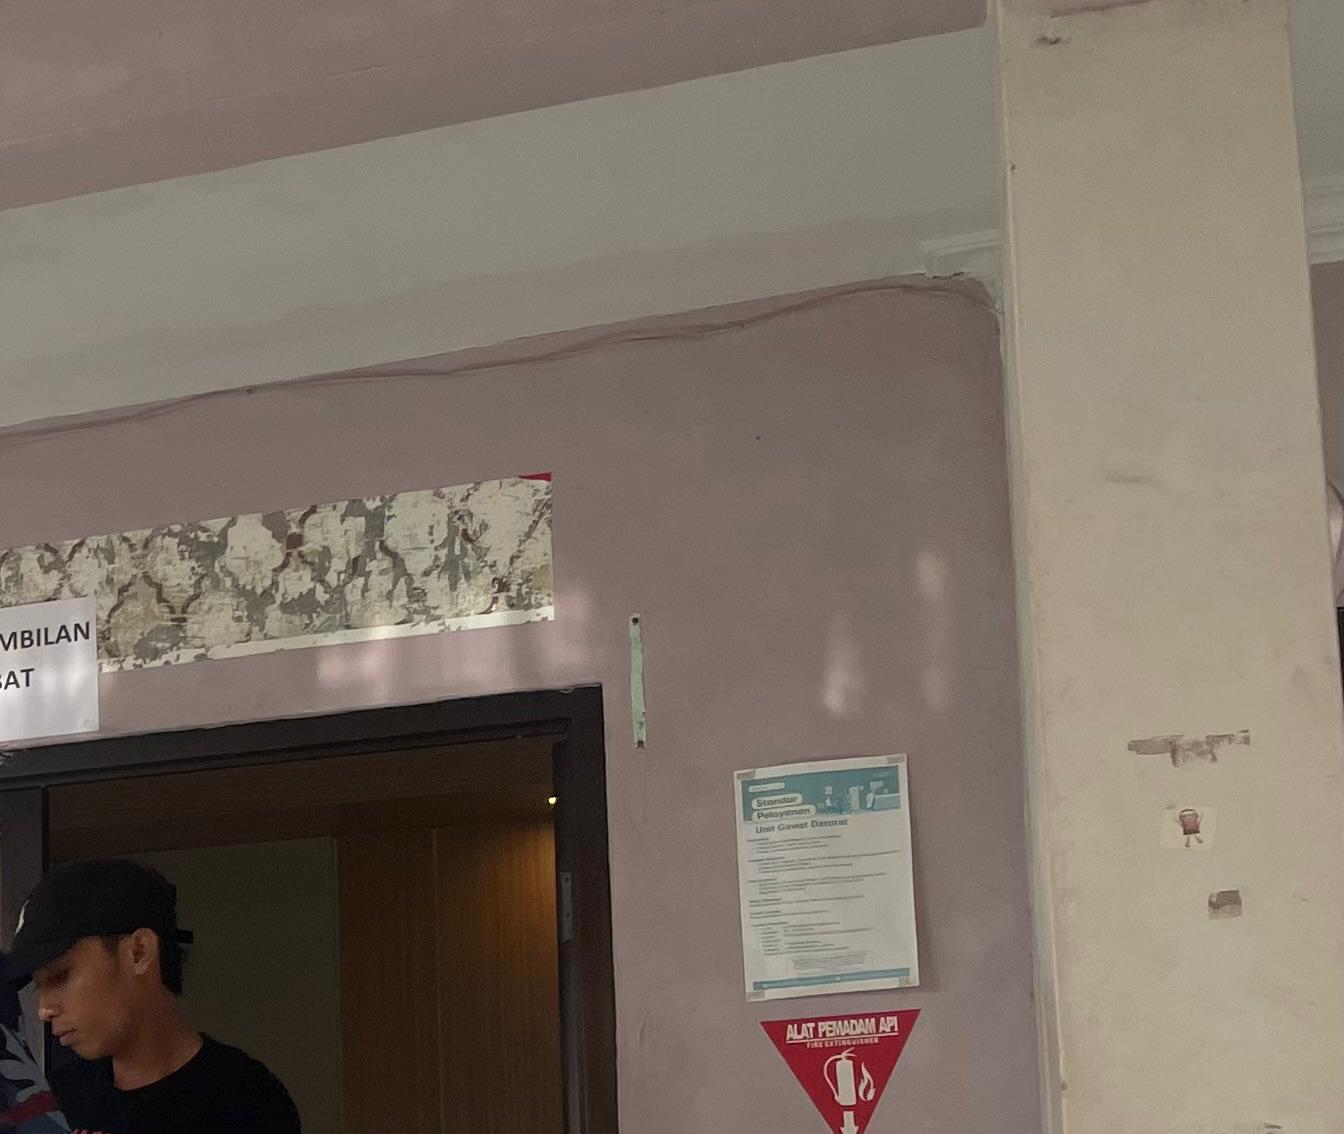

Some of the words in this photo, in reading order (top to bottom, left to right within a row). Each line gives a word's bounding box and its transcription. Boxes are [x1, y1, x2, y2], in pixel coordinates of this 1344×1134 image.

[786, 1023, 815, 1040] ALAT
[818, 1017, 876, 1038] PEMADAM
[879, 1016, 899, 1033] API
